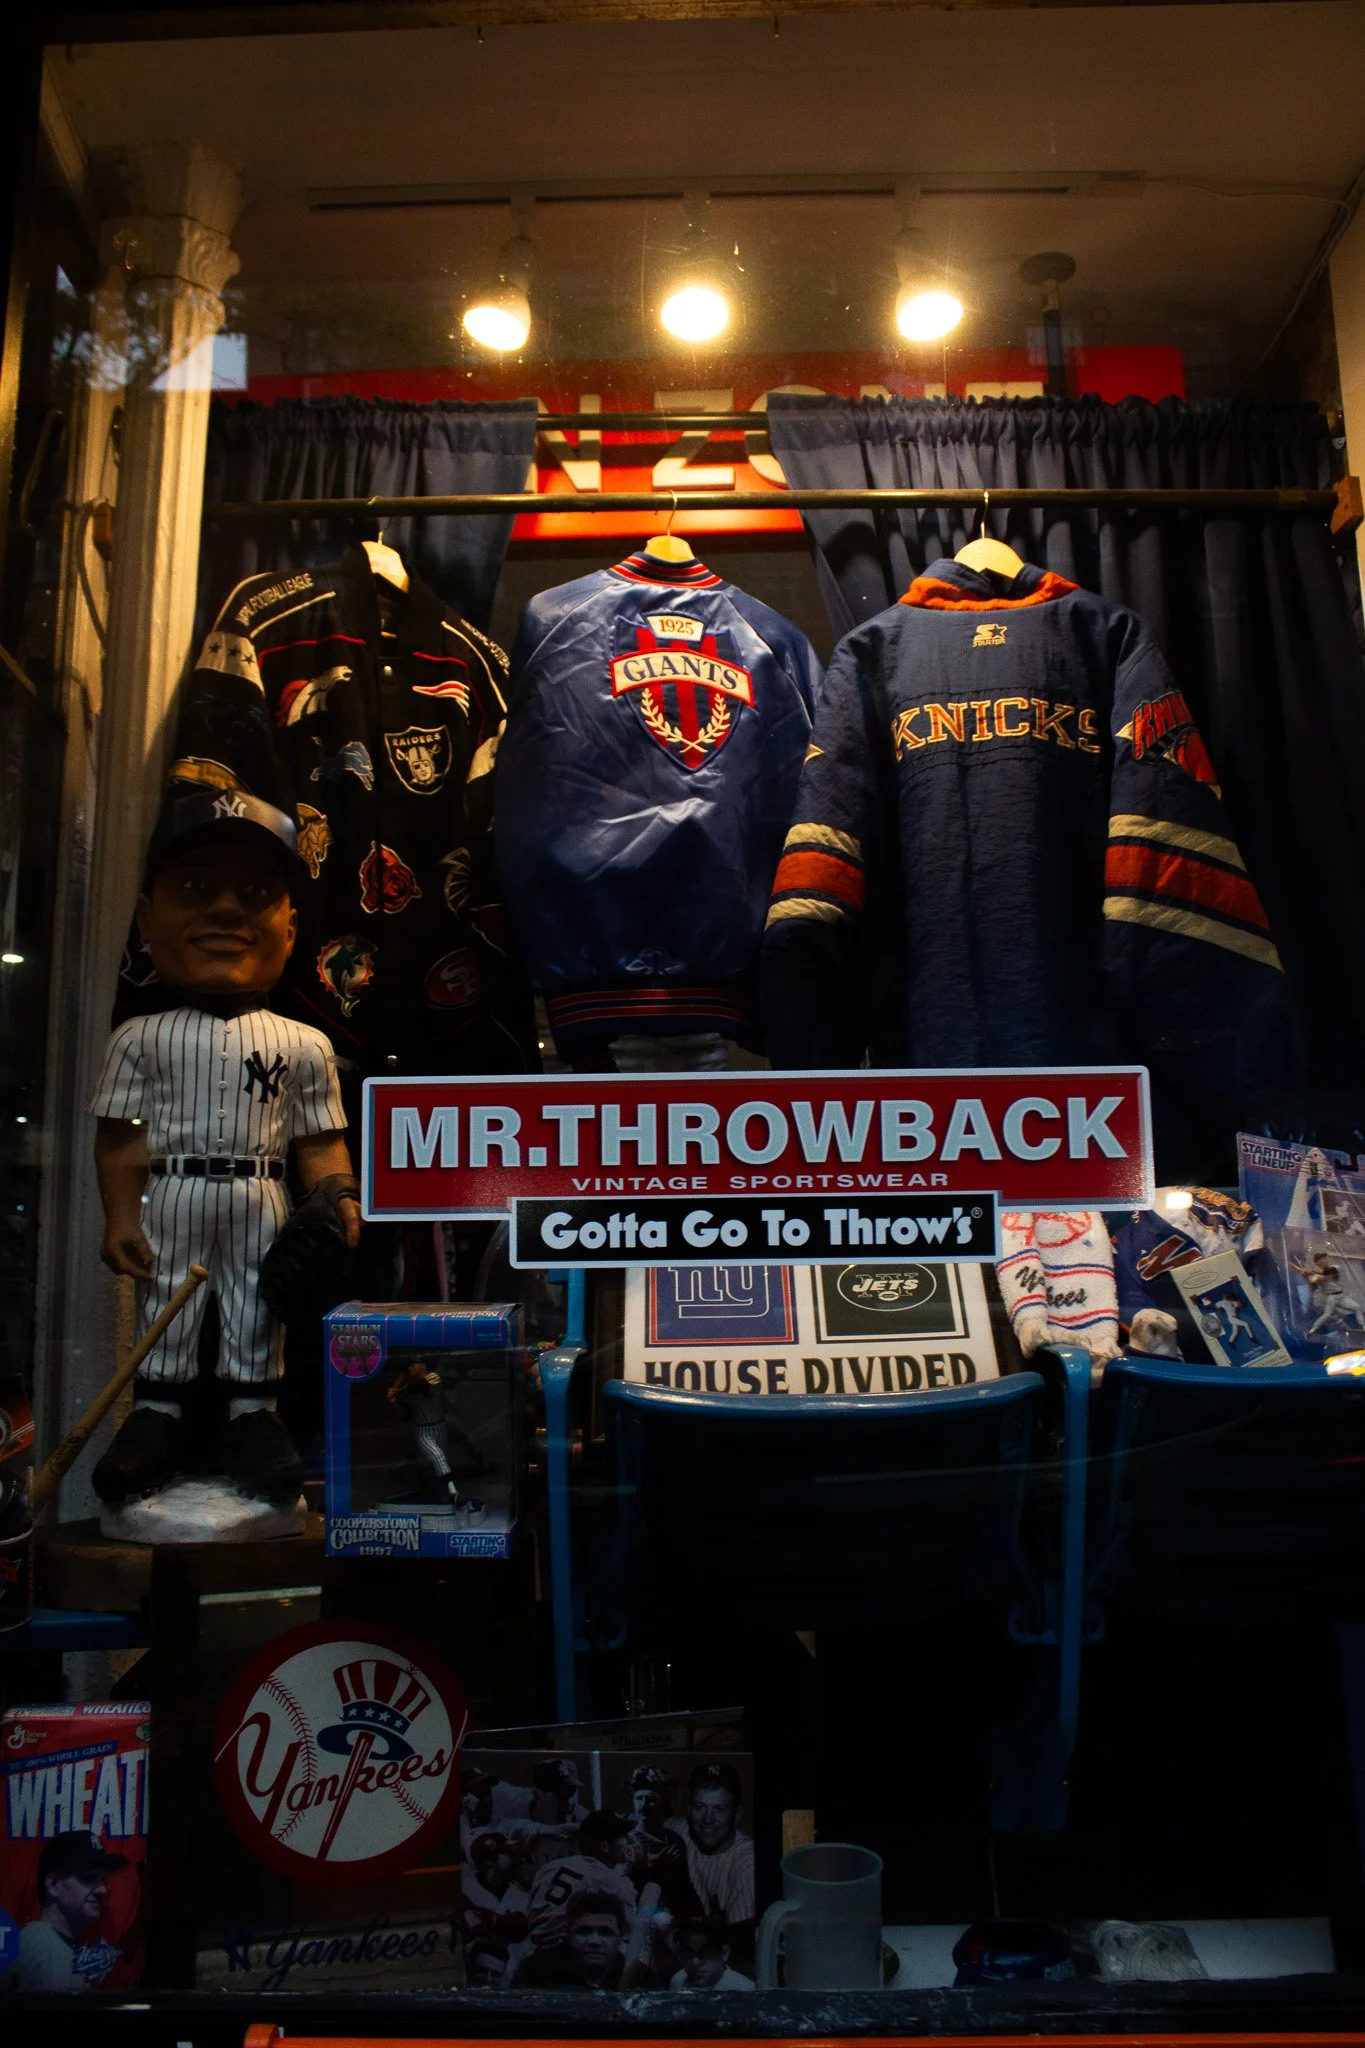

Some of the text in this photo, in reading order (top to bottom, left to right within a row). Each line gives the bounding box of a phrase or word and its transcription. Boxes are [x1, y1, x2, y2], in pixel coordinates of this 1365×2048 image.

[659, 619, 694, 635] 1925
[623, 655, 739, 690] GIANTS
[890, 697, 1103, 761] KNICKS
[392, 732, 441, 747] RAIDERS
[1242, 1142, 1301, 1162] STARTING
[1251, 1153, 1296, 1171] LINEUP
[571, 1173, 949, 1191] VINTAGE SPORTSWEAR
[540, 1210, 668, 1250] Gotta
[681, 1209, 749, 1248] Go
[761, 1208, 811, 1247] To
[852, 1277, 919, 1293] JETS
[331, 1324, 381, 1335] STADIUM
[338, 1335, 378, 1346] STARS
[643, 1353, 977, 1395] HOUSE DIVIDED
[330, 1517, 420, 1529] COOPERSTOWN
[330, 1529, 421, 1551] COLLECTION
[452, 1535, 505, 1547] STARTING
[360, 1545, 393, 1556] 1997
[459, 1546, 499, 1556] LINEUP
[214, 1709, 468, 1861] Yankees
[545, 1866, 584, 1905] 5
[260, 1912, 440, 1992] Yankees
